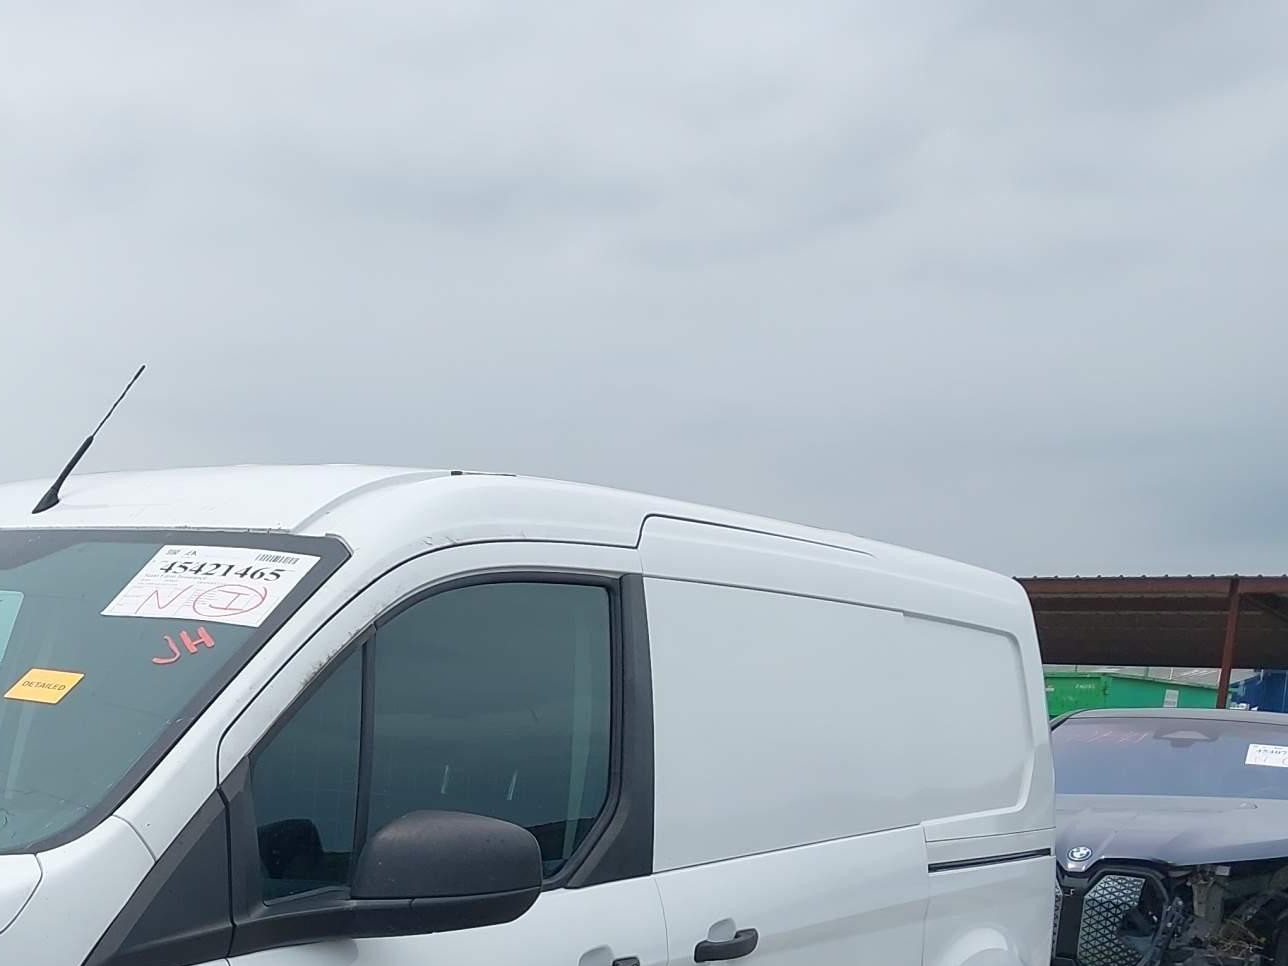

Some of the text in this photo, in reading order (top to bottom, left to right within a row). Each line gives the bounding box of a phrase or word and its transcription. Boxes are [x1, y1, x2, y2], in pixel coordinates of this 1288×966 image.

[159, 561, 283, 582] 45421465
[152, 626, 215, 664] JH
[22, 680, 67, 692] DETAILED
